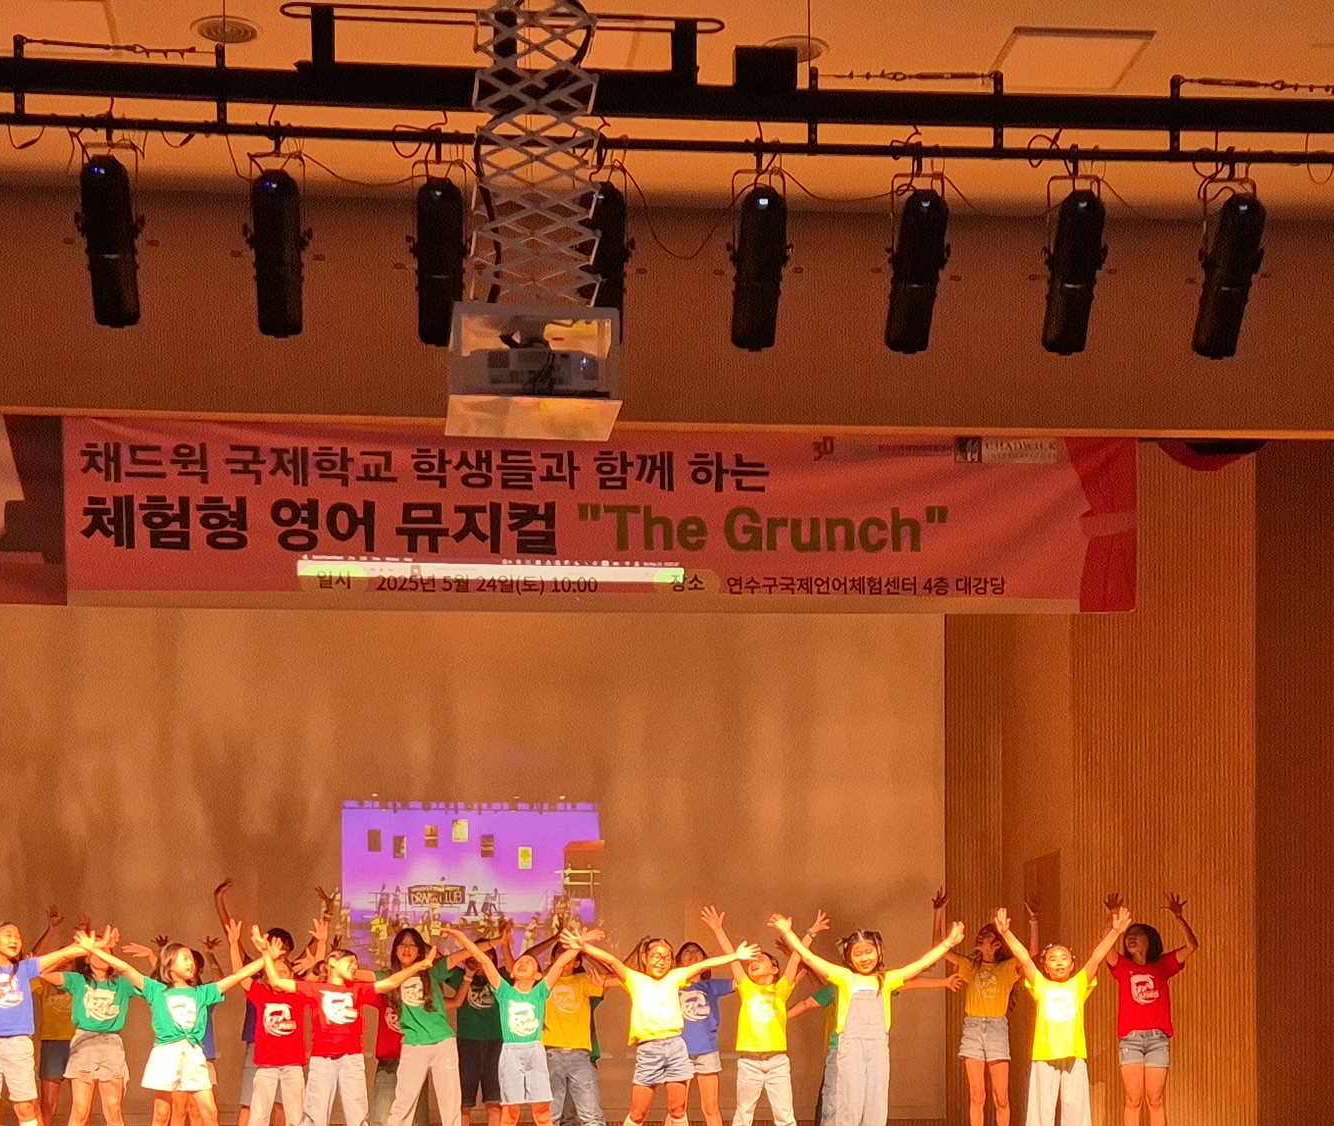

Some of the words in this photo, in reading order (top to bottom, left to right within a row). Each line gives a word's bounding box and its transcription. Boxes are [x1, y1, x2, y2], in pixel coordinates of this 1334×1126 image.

[80, 442, 209, 484] 채드윅
[225, 444, 398, 487] 국제학교
[411, 448, 580, 490] 학생들과
[593, 450, 675, 492] 함께
[688, 452, 770, 493] 하는
[80, 495, 249, 550] 체험형
[270, 498, 376, 552] 영어
[395, 501, 557, 554] 뮤지컬
[578, 503, 708, 551] "The
[724, 505, 948, 552] Grunch"
[317, 571, 351, 590] 일시
[376, 574, 436, 592] 2025년
[442, 574, 470, 593] 5월
[476, 575, 545, 595] 24일(토)
[551, 576, 598, 593] 10:00
[670, 574, 705, 592] 장소
[726, 576, 917, 595] 연수구국제언어체험센터
[923, 577, 949, 595] 4층
[955, 576, 1006, 596] 대강당
